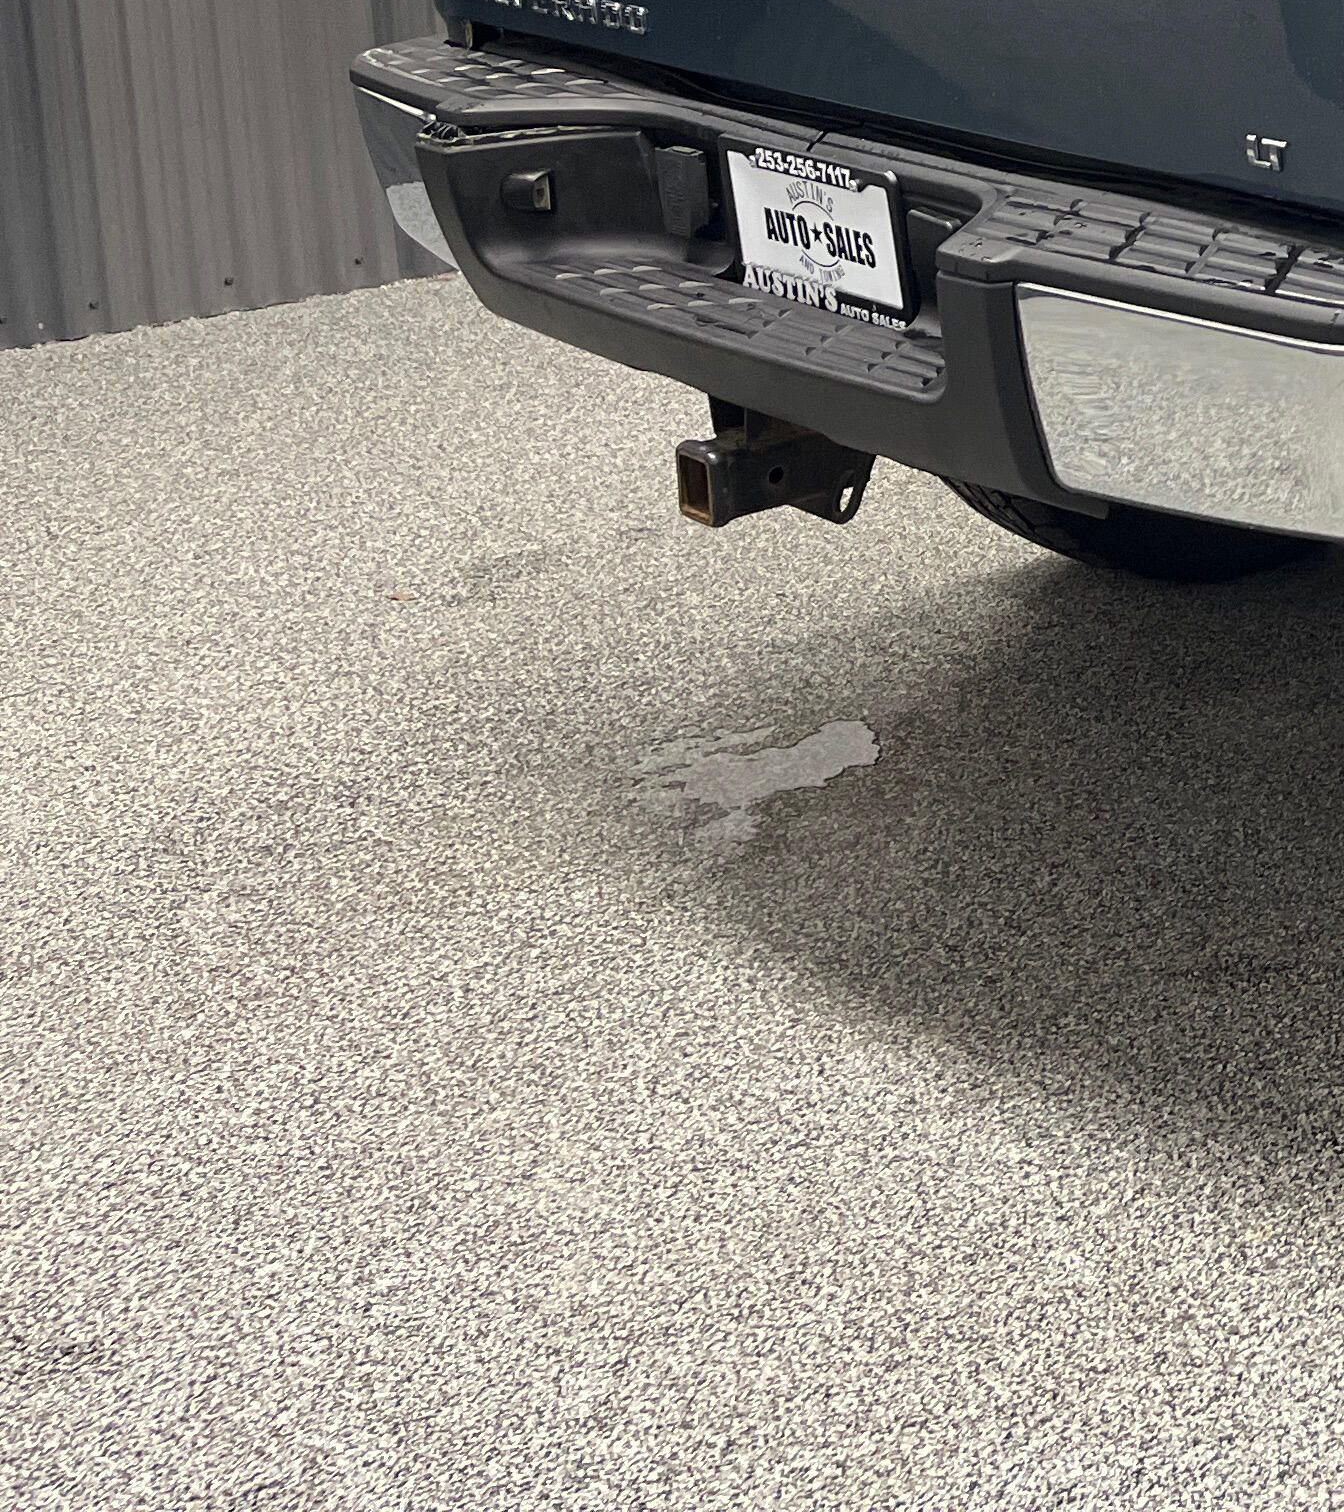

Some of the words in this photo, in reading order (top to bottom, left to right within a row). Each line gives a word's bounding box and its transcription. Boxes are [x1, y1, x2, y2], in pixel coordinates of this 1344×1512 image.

[755, 147, 851, 188] 253-256-7117
[785, 180, 834, 213] AUSTIN'S
[764, 207, 811, 250] AUTO
[822, 222, 876, 269] SALES
[743, 264, 839, 314] AUSTIN'S
[840, 303, 869, 322] AUTO
[872, 311, 907, 331] SALES
